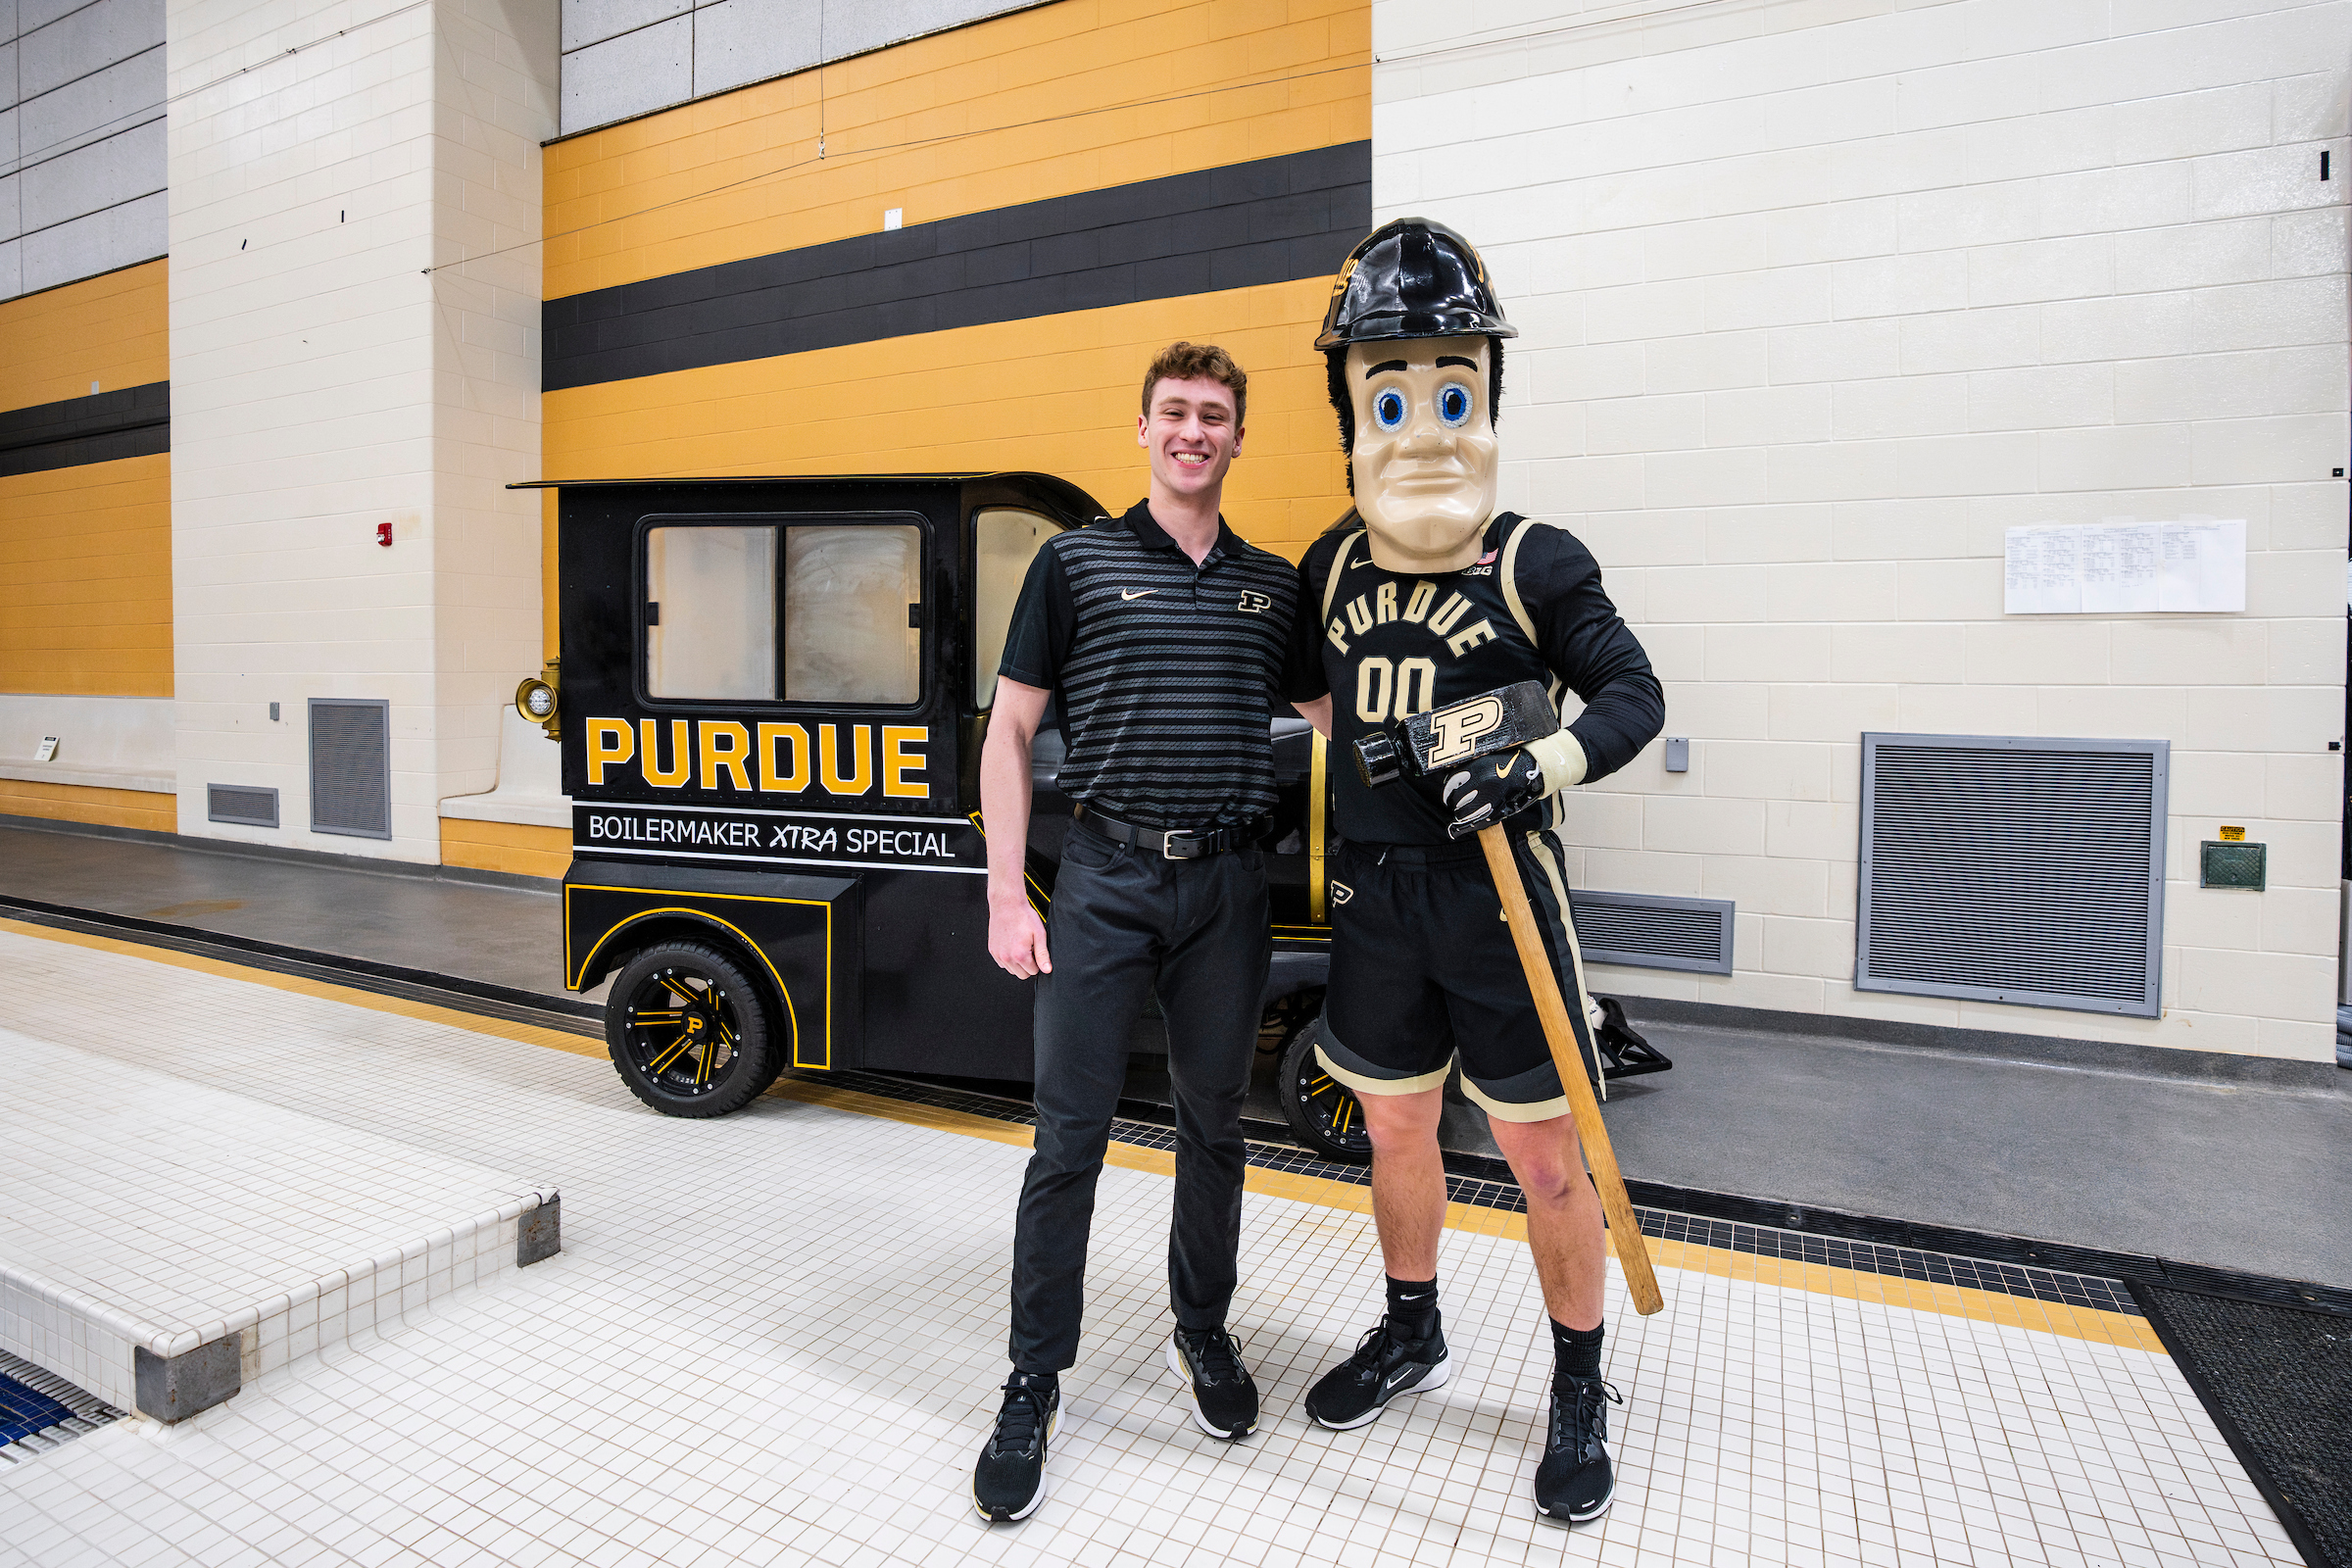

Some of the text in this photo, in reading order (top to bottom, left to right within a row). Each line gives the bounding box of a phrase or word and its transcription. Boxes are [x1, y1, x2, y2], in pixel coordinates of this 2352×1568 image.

[1238, 590, 1271, 612] P
[1327, 579, 1499, 660] PURDUE
[1356, 655, 1438, 723] 00
[586, 716, 930, 799] PURDUE
[1428, 696, 1503, 768] P
[589, 815, 956, 858] BOILERMAKER XTRA SPECIAL
[687, 1016, 704, 1034] P
